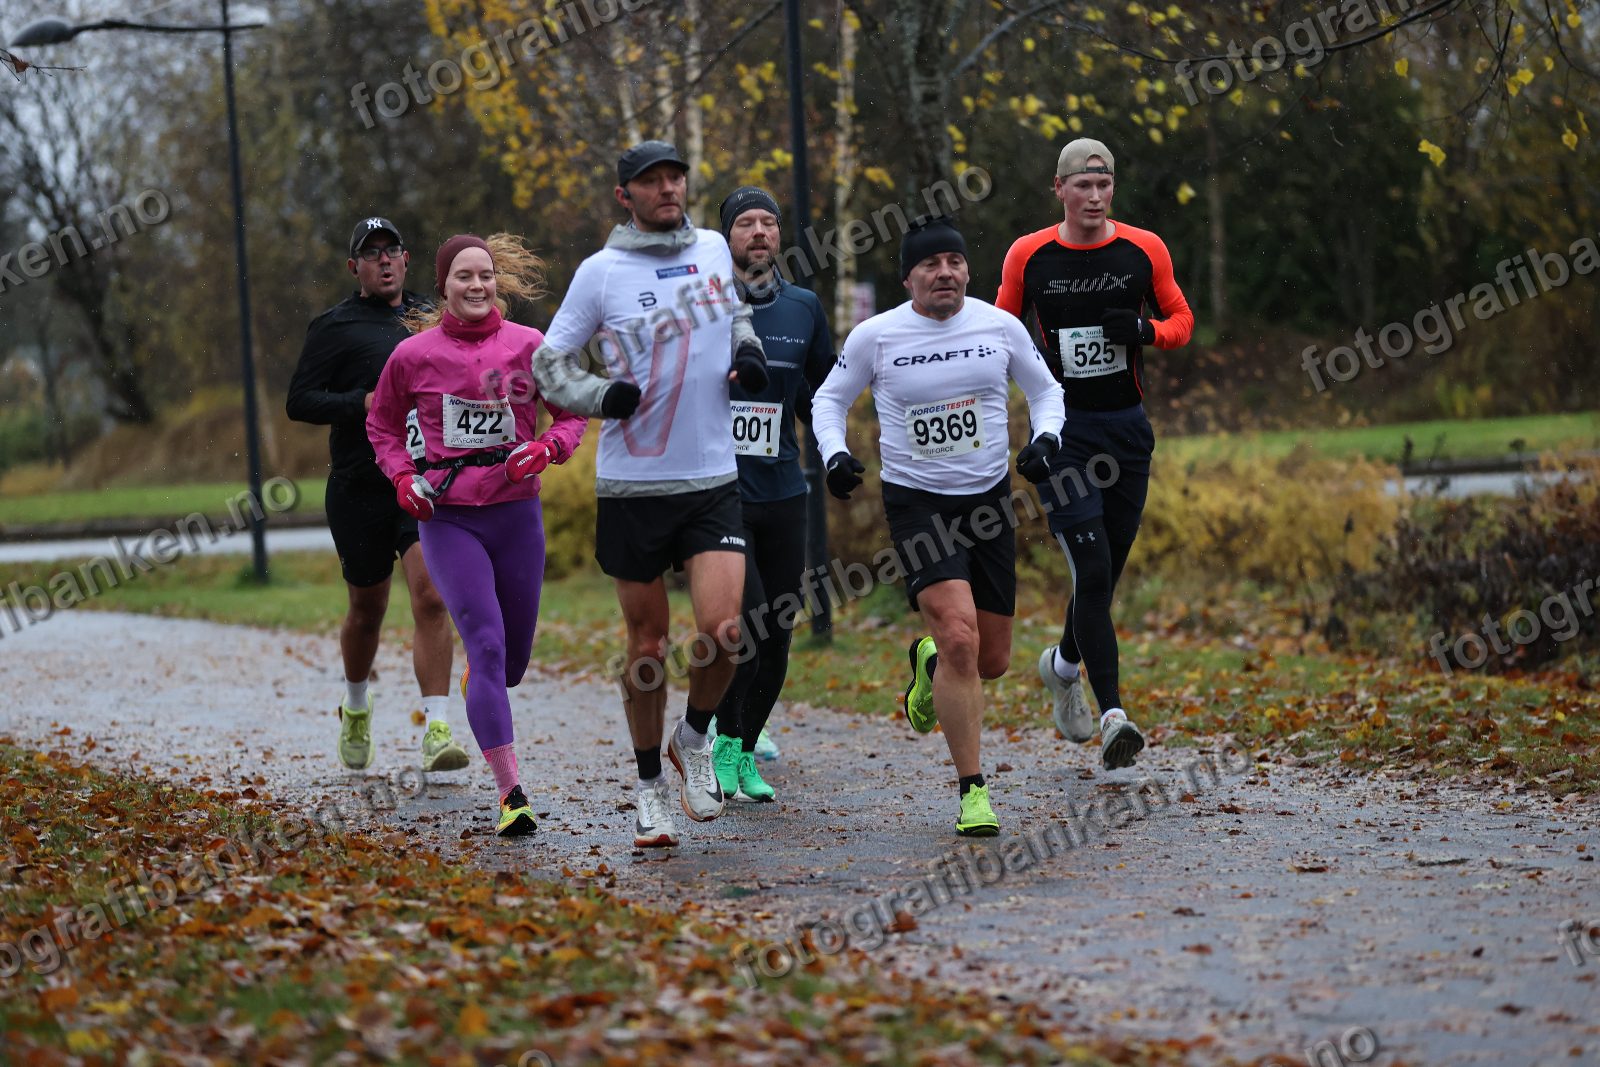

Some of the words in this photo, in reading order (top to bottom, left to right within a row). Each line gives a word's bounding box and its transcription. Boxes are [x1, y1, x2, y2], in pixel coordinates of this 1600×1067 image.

[893, 348, 975, 367] CRAFT
[1075, 342, 1115, 367] 525
[449, 398, 511, 409] NORGESTESTEN
[911, 398, 976, 416] NORGESTESTEN
[457, 410, 503, 434] 422
[733, 416, 771, 443] 001
[913, 410, 977, 445] 9369
